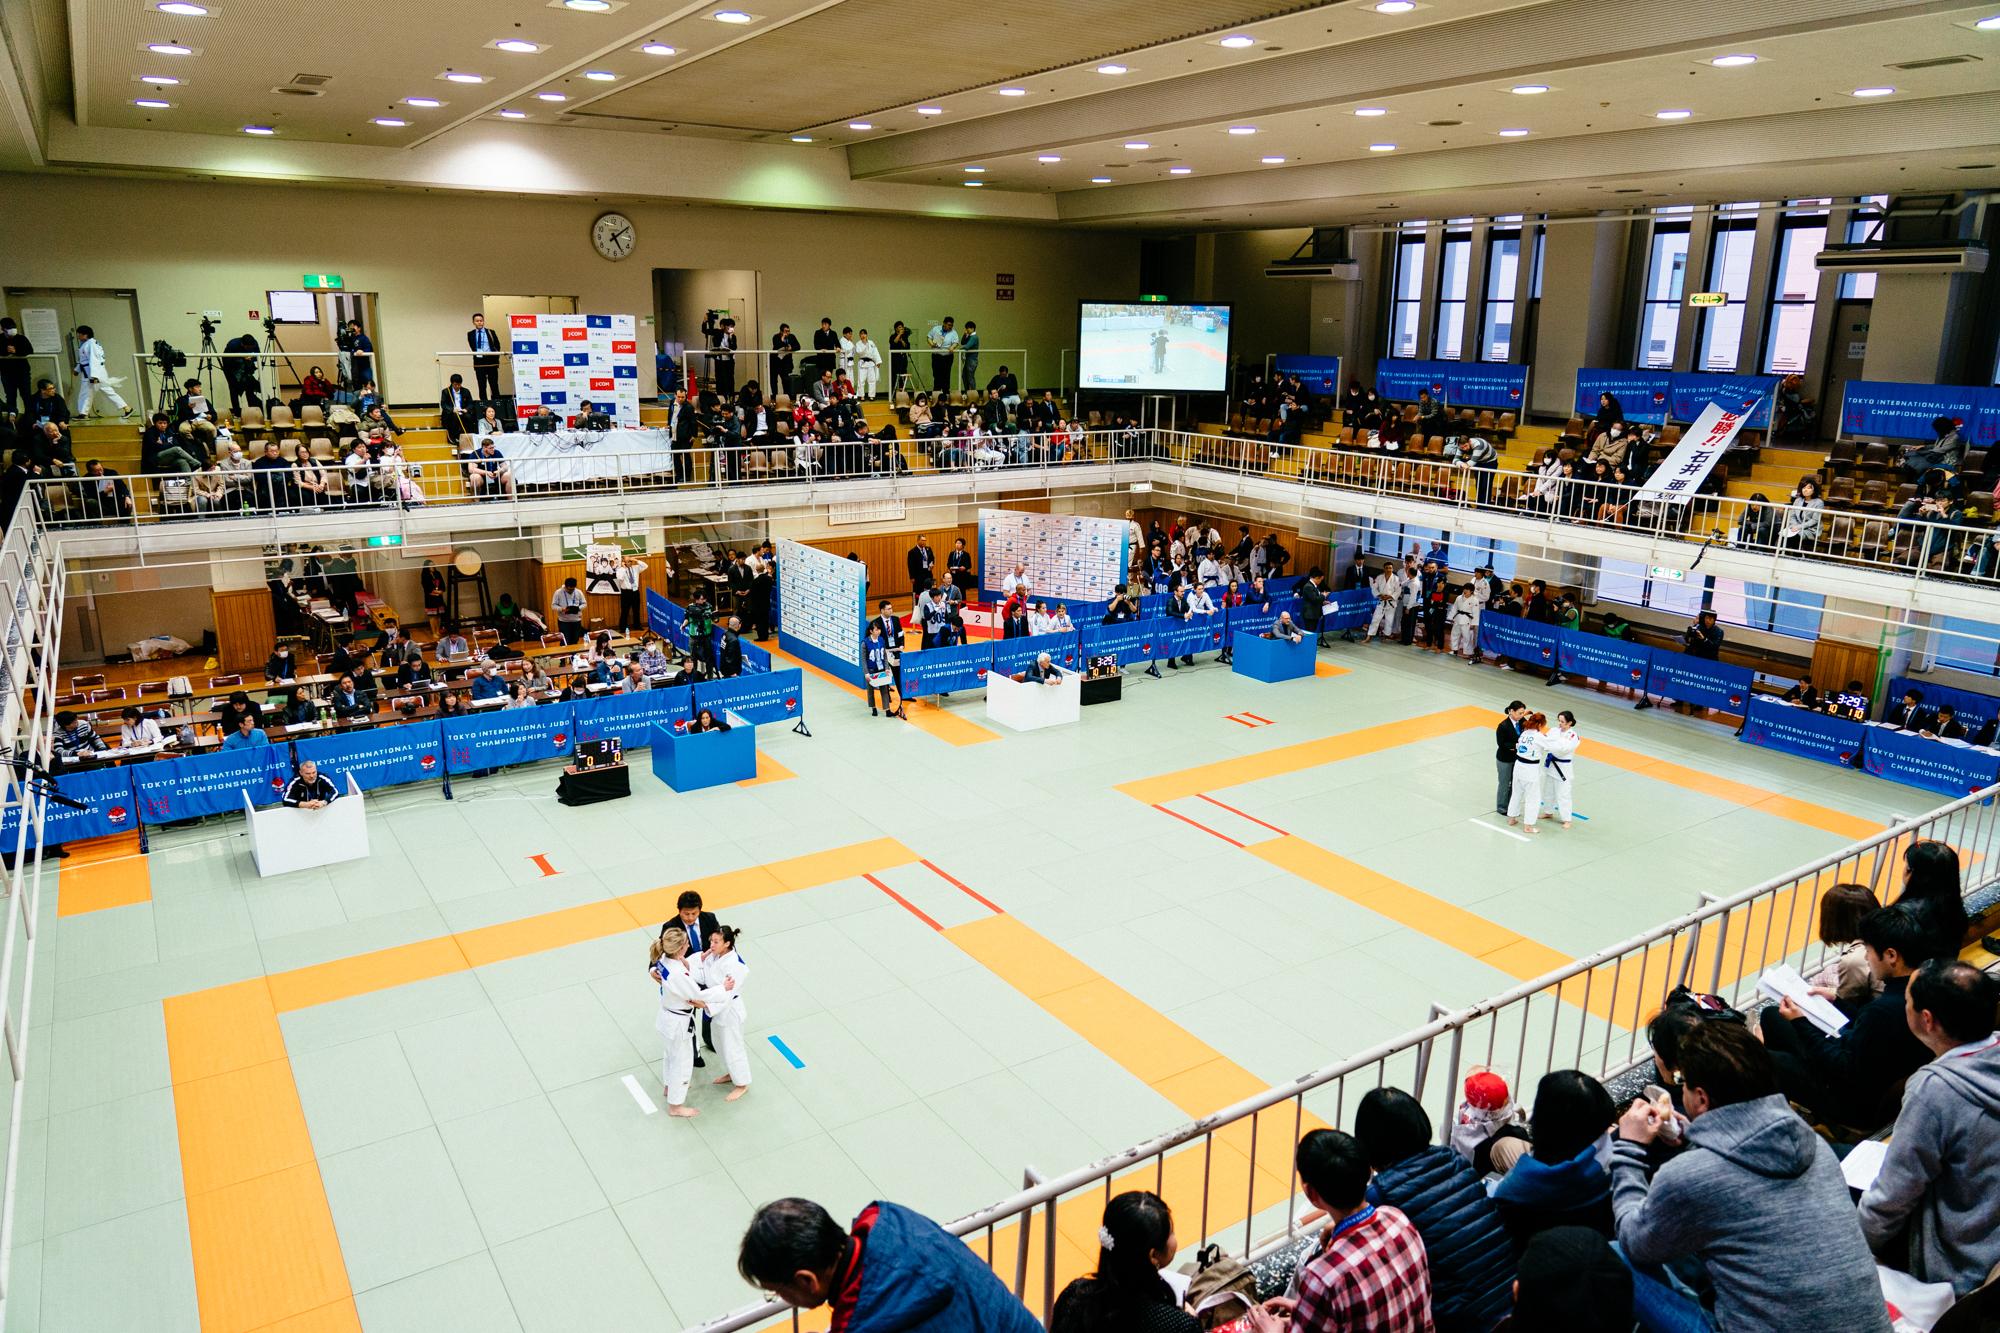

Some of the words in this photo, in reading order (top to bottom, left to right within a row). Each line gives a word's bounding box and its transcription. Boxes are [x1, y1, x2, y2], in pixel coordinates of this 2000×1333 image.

[1848, 397, 1875, 405] TOKYO
[1876, 399, 1945, 409] INTERNATIONAL
[1578, 653, 1628, 669] CHAMPIONSHIPS
[1582, 646, 1629, 661] INTERNATIONAL
[922, 668, 974, 679] CHAMPIONSHIPS
[926, 660, 973, 670] INTERNATIONAL
[1653, 664, 1674, 673] TOKYO
[1675, 670, 1727, 686] INTERNATIONAL
[1729, 682, 1748, 691] JUDO
[1671, 677, 1727, 694] CHAMPIONSHIPS
[700, 698, 723, 708] TOKYO
[724, 689, 780, 703] INTERNATIONAL
[782, 685, 799, 694] JUDO
[722, 698, 781, 713] CAMPIONSHIPS
[1837, 694, 1860, 707] 3:29
[580, 717, 604, 726] TOKYO
[607, 710, 668, 722] INTERNATIONAL
[670, 705, 688, 714] JUDO
[1920, 703, 1984, 722] INTETIONAL
[448, 732, 476, 741] TOKYO
[479, 723, 546, 737] INTERNATIONAL
[549, 719, 570, 728] JUDO
[604, 718, 668, 732] CHAMPIONSIPS
[1750, 716, 1774, 728] TOKYO
[1776, 724, 1836, 742] INTERNATIONAL
[1839, 739, 1860, 747] JUDO
[476, 732, 548, 748] CHAMPIONSHIPS
[1770, 731, 1835, 752] CHAMPIONSHIPS
[339, 744, 412, 762] INTERNATIONAL
[415, 740, 438, 750] JUDO
[335, 754, 414, 774] CHAMPIONSHIPS
[1868, 746, 1894, 758] TOKYO
[1896, 754, 1965, 776] INTERNATIONAL
[1968, 772, 1992, 782] JUDO
[1891, 762, 1964, 785] CHAMPIONSHIPS
[141, 779, 176, 790] TOKYO
[179, 766, 262, 784] INTERNATIONAL
[265, 762, 286, 771] JUDO
[101, 790, 128, 800] JUDO
[176, 777, 264, 796] CHAMPIONSHIPS
